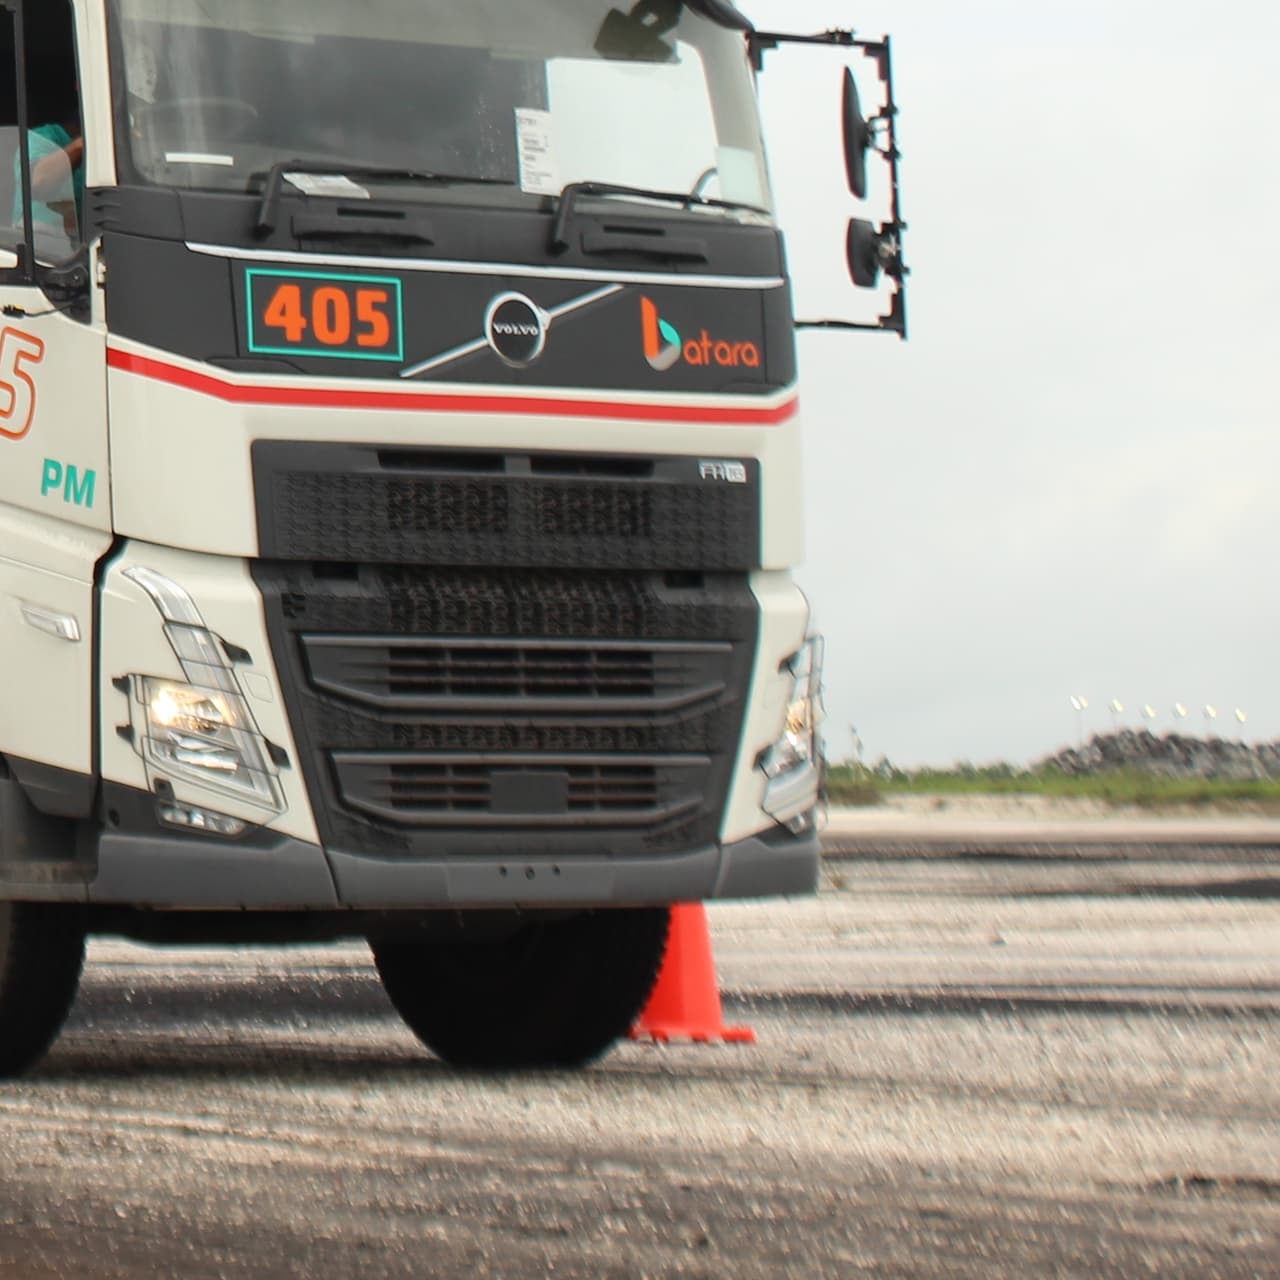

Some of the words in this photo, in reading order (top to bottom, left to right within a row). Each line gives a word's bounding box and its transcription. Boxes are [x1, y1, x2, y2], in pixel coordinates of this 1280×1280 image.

[264, 283, 390, 347] 405
[493, 323, 538, 336] VOLVO
[40, 458, 96, 509] PM
